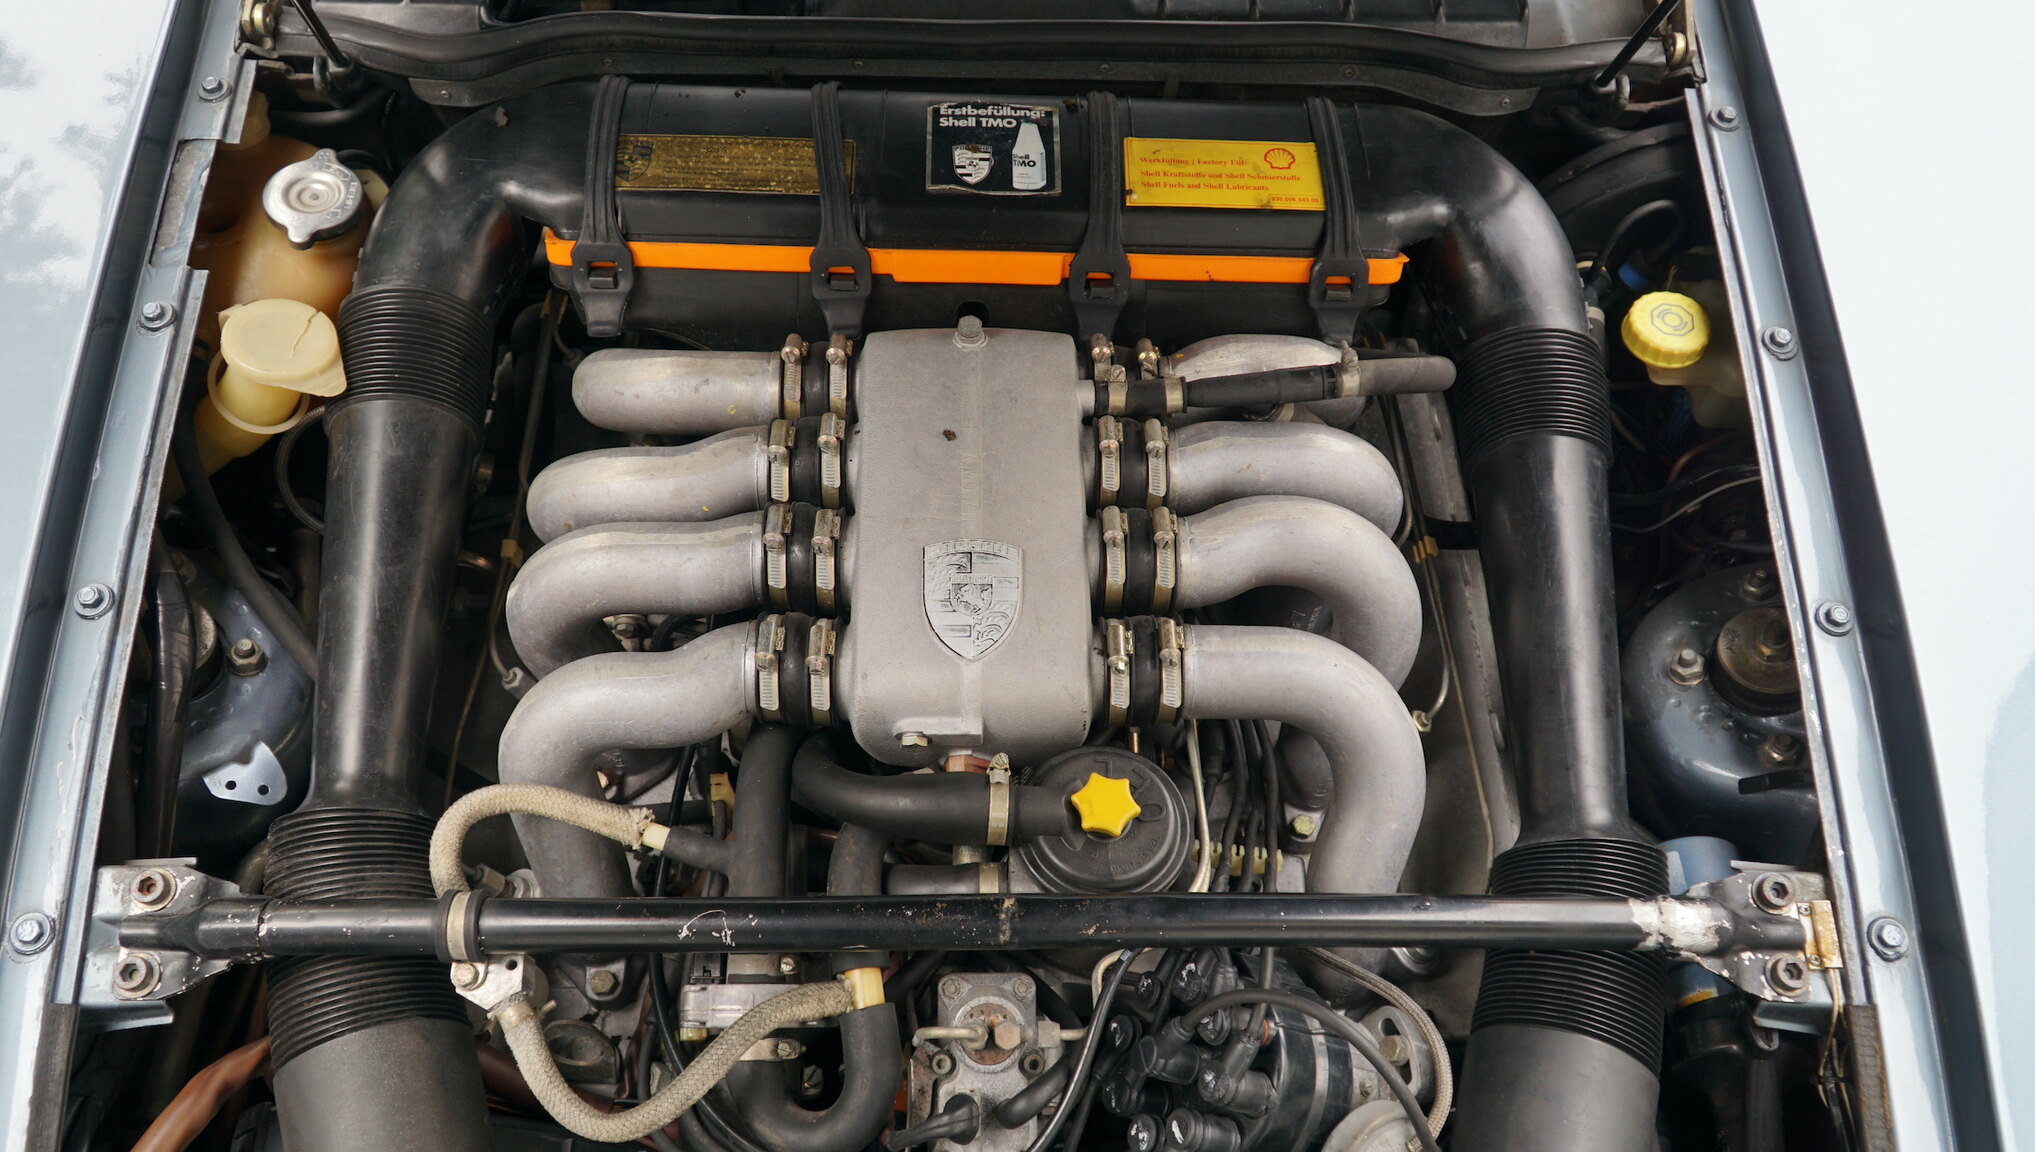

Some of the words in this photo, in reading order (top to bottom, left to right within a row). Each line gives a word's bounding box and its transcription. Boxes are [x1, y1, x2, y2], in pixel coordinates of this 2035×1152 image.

[940, 104, 1046, 119] Erstbefüllung:
[939, 117, 976, 128] Shell
[979, 117, 1017, 128] TMO
[1013, 159, 1037, 168] TMO
[1197, 158, 1228, 167] Factory
[1163, 170, 1206, 179] Kraftstoffe
[1247, 173, 1301, 181] Schmierstoffe
[1164, 181, 1185, 189] Fuels
[1203, 182, 1224, 190] Shell
[1227, 183, 1269, 191] Lubricants
